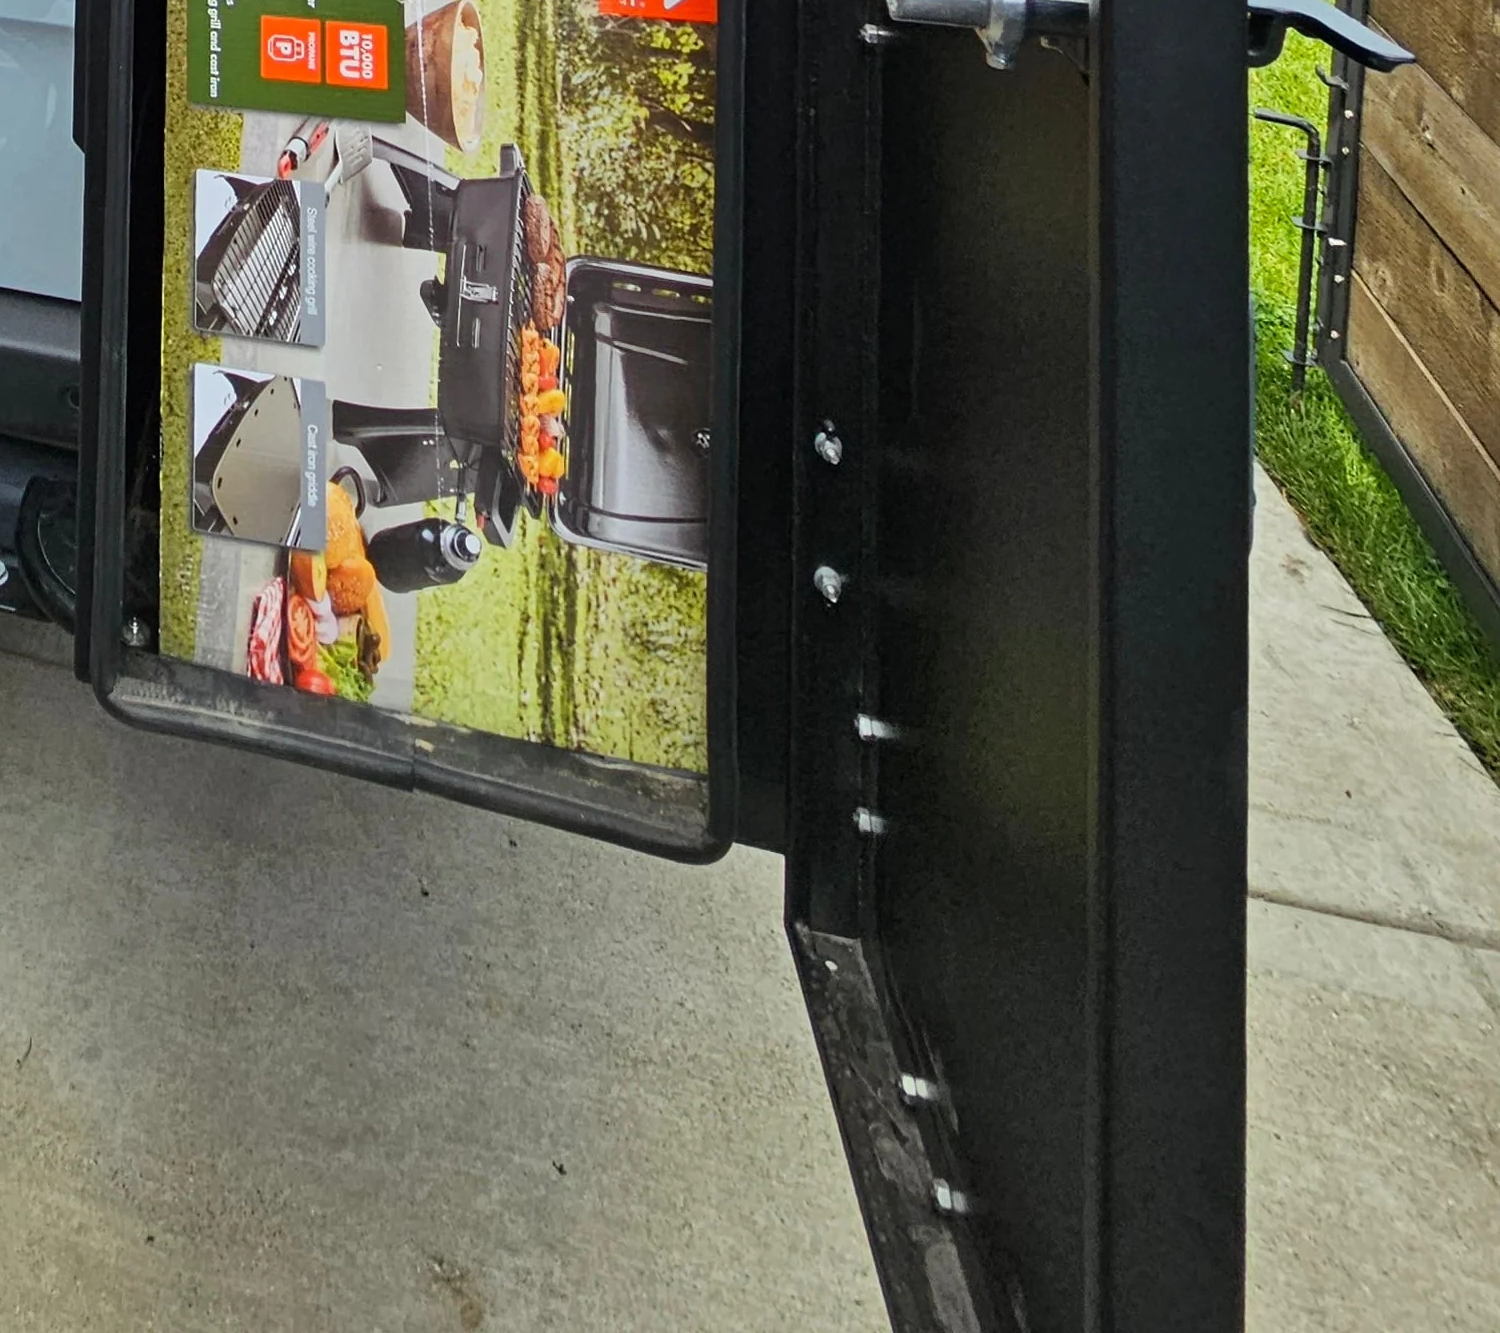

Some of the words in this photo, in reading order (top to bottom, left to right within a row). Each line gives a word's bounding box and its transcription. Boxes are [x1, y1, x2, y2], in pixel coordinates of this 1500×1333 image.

[208, 8, 221, 29] grill
[210, 31, 221, 51] and
[275, 41, 292, 55] P
[210, 54, 219, 75] cast
[340, 29, 360, 79] BTU
[360, 33, 373, 79] 10,000
[210, 77, 220, 98] iron
[307, 207, 318, 233] Steel
[307, 235, 317, 255] wire
[305, 257, 318, 294] cooking
[305, 297, 318, 315] grill
[308, 424, 318, 448] Cast
[308, 450, 318, 469] iron
[304, 471, 318, 507] griddle
